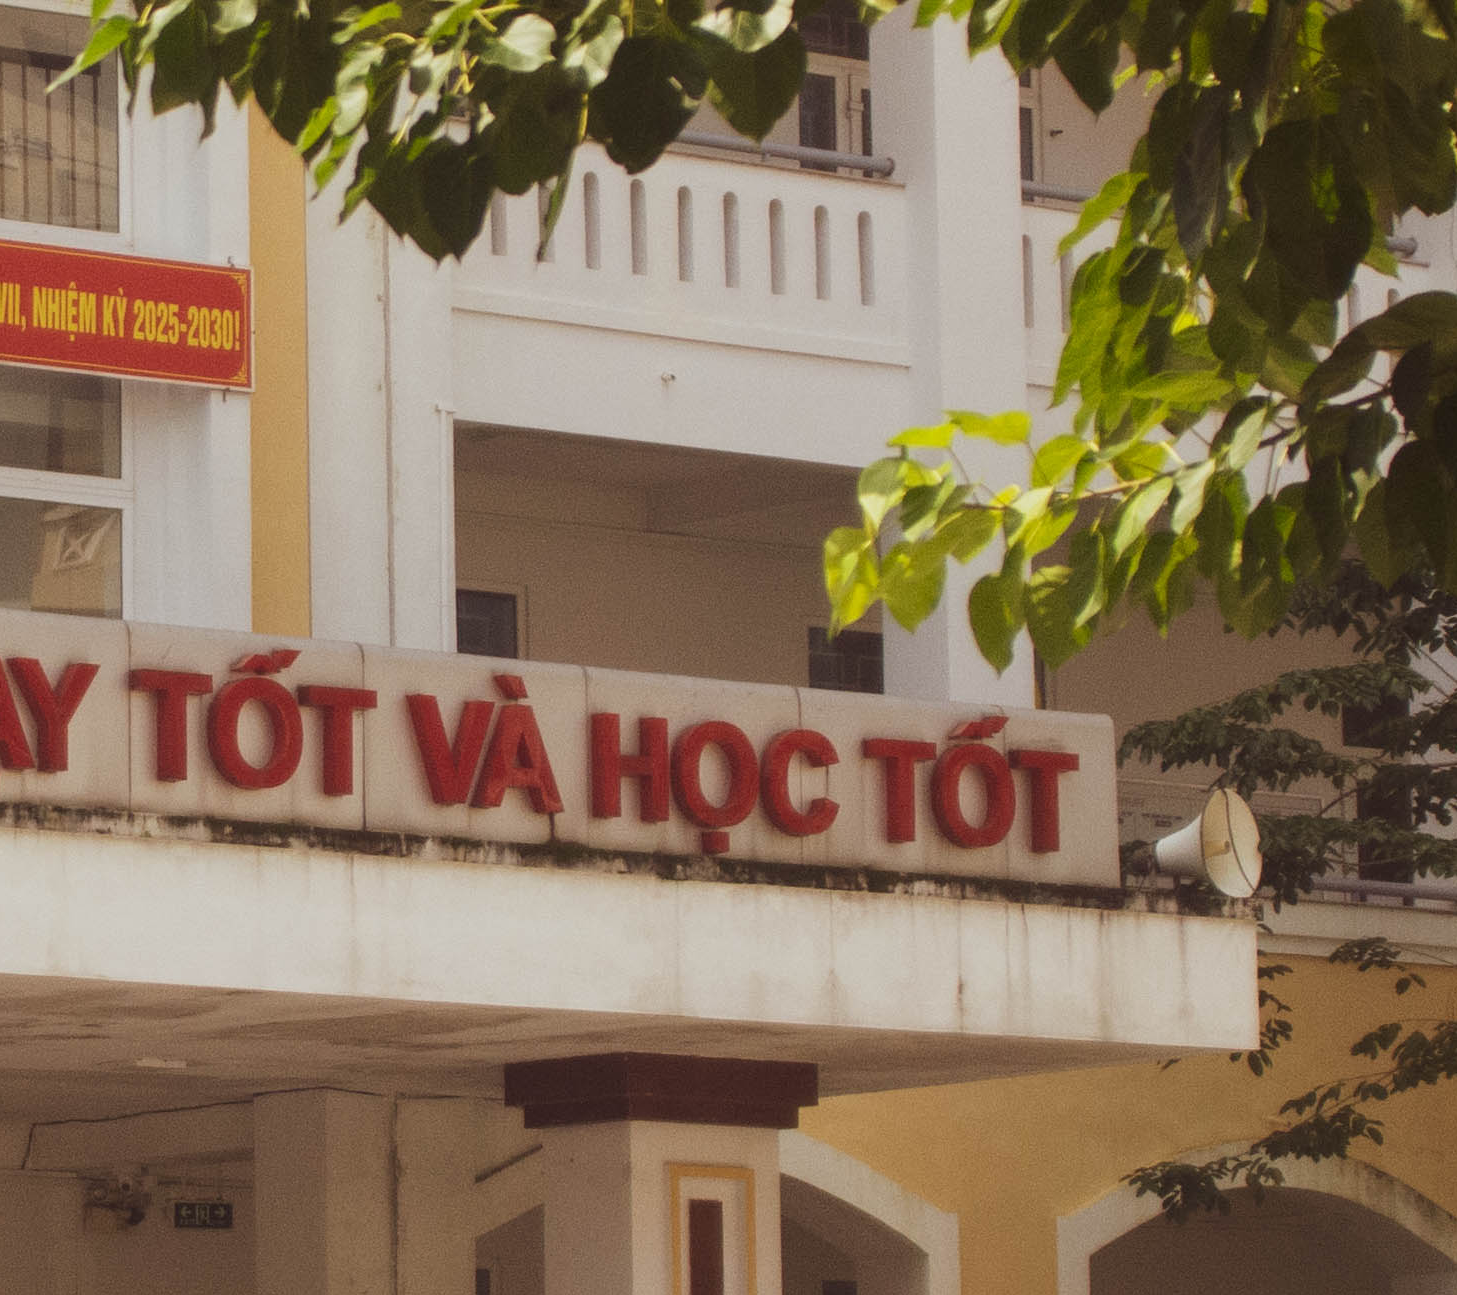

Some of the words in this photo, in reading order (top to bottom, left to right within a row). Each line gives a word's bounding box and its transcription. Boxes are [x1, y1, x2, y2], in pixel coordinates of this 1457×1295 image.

[33, 281, 97, 342] NHIỆM
[103, 287, 128, 338] KỲ
[133, 299, 241, 352] 2025-2030!
[129, 648, 378, 798] TỐT
[406, 674, 564, 816] VÀ
[590, 711, 841, 856] HỌC
[862, 715, 1080, 855] TỐT
